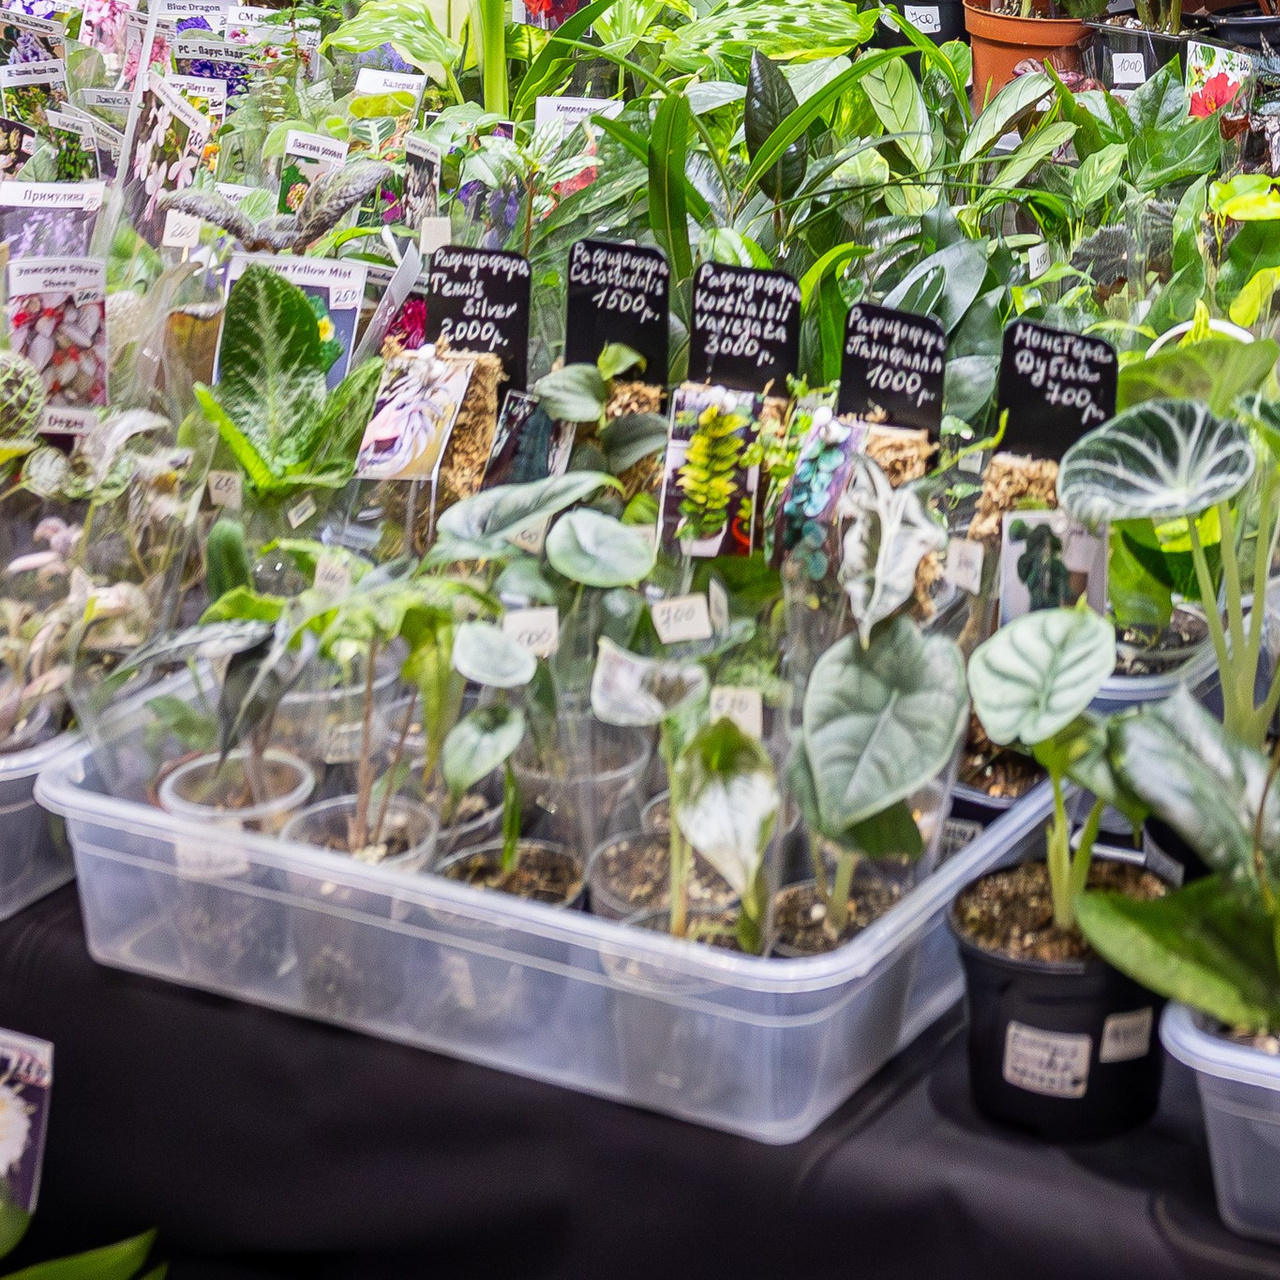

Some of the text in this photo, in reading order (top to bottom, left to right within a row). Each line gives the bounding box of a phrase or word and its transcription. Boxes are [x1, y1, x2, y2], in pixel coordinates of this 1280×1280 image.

[166, 2, 221, 13] Blue Dragon
[1117, 58, 1143, 73] 1000
[23, 189, 85, 204] Примулина
[291, 264, 327, 276] Yellow
[1013, 324, 1114, 364] Монстера
